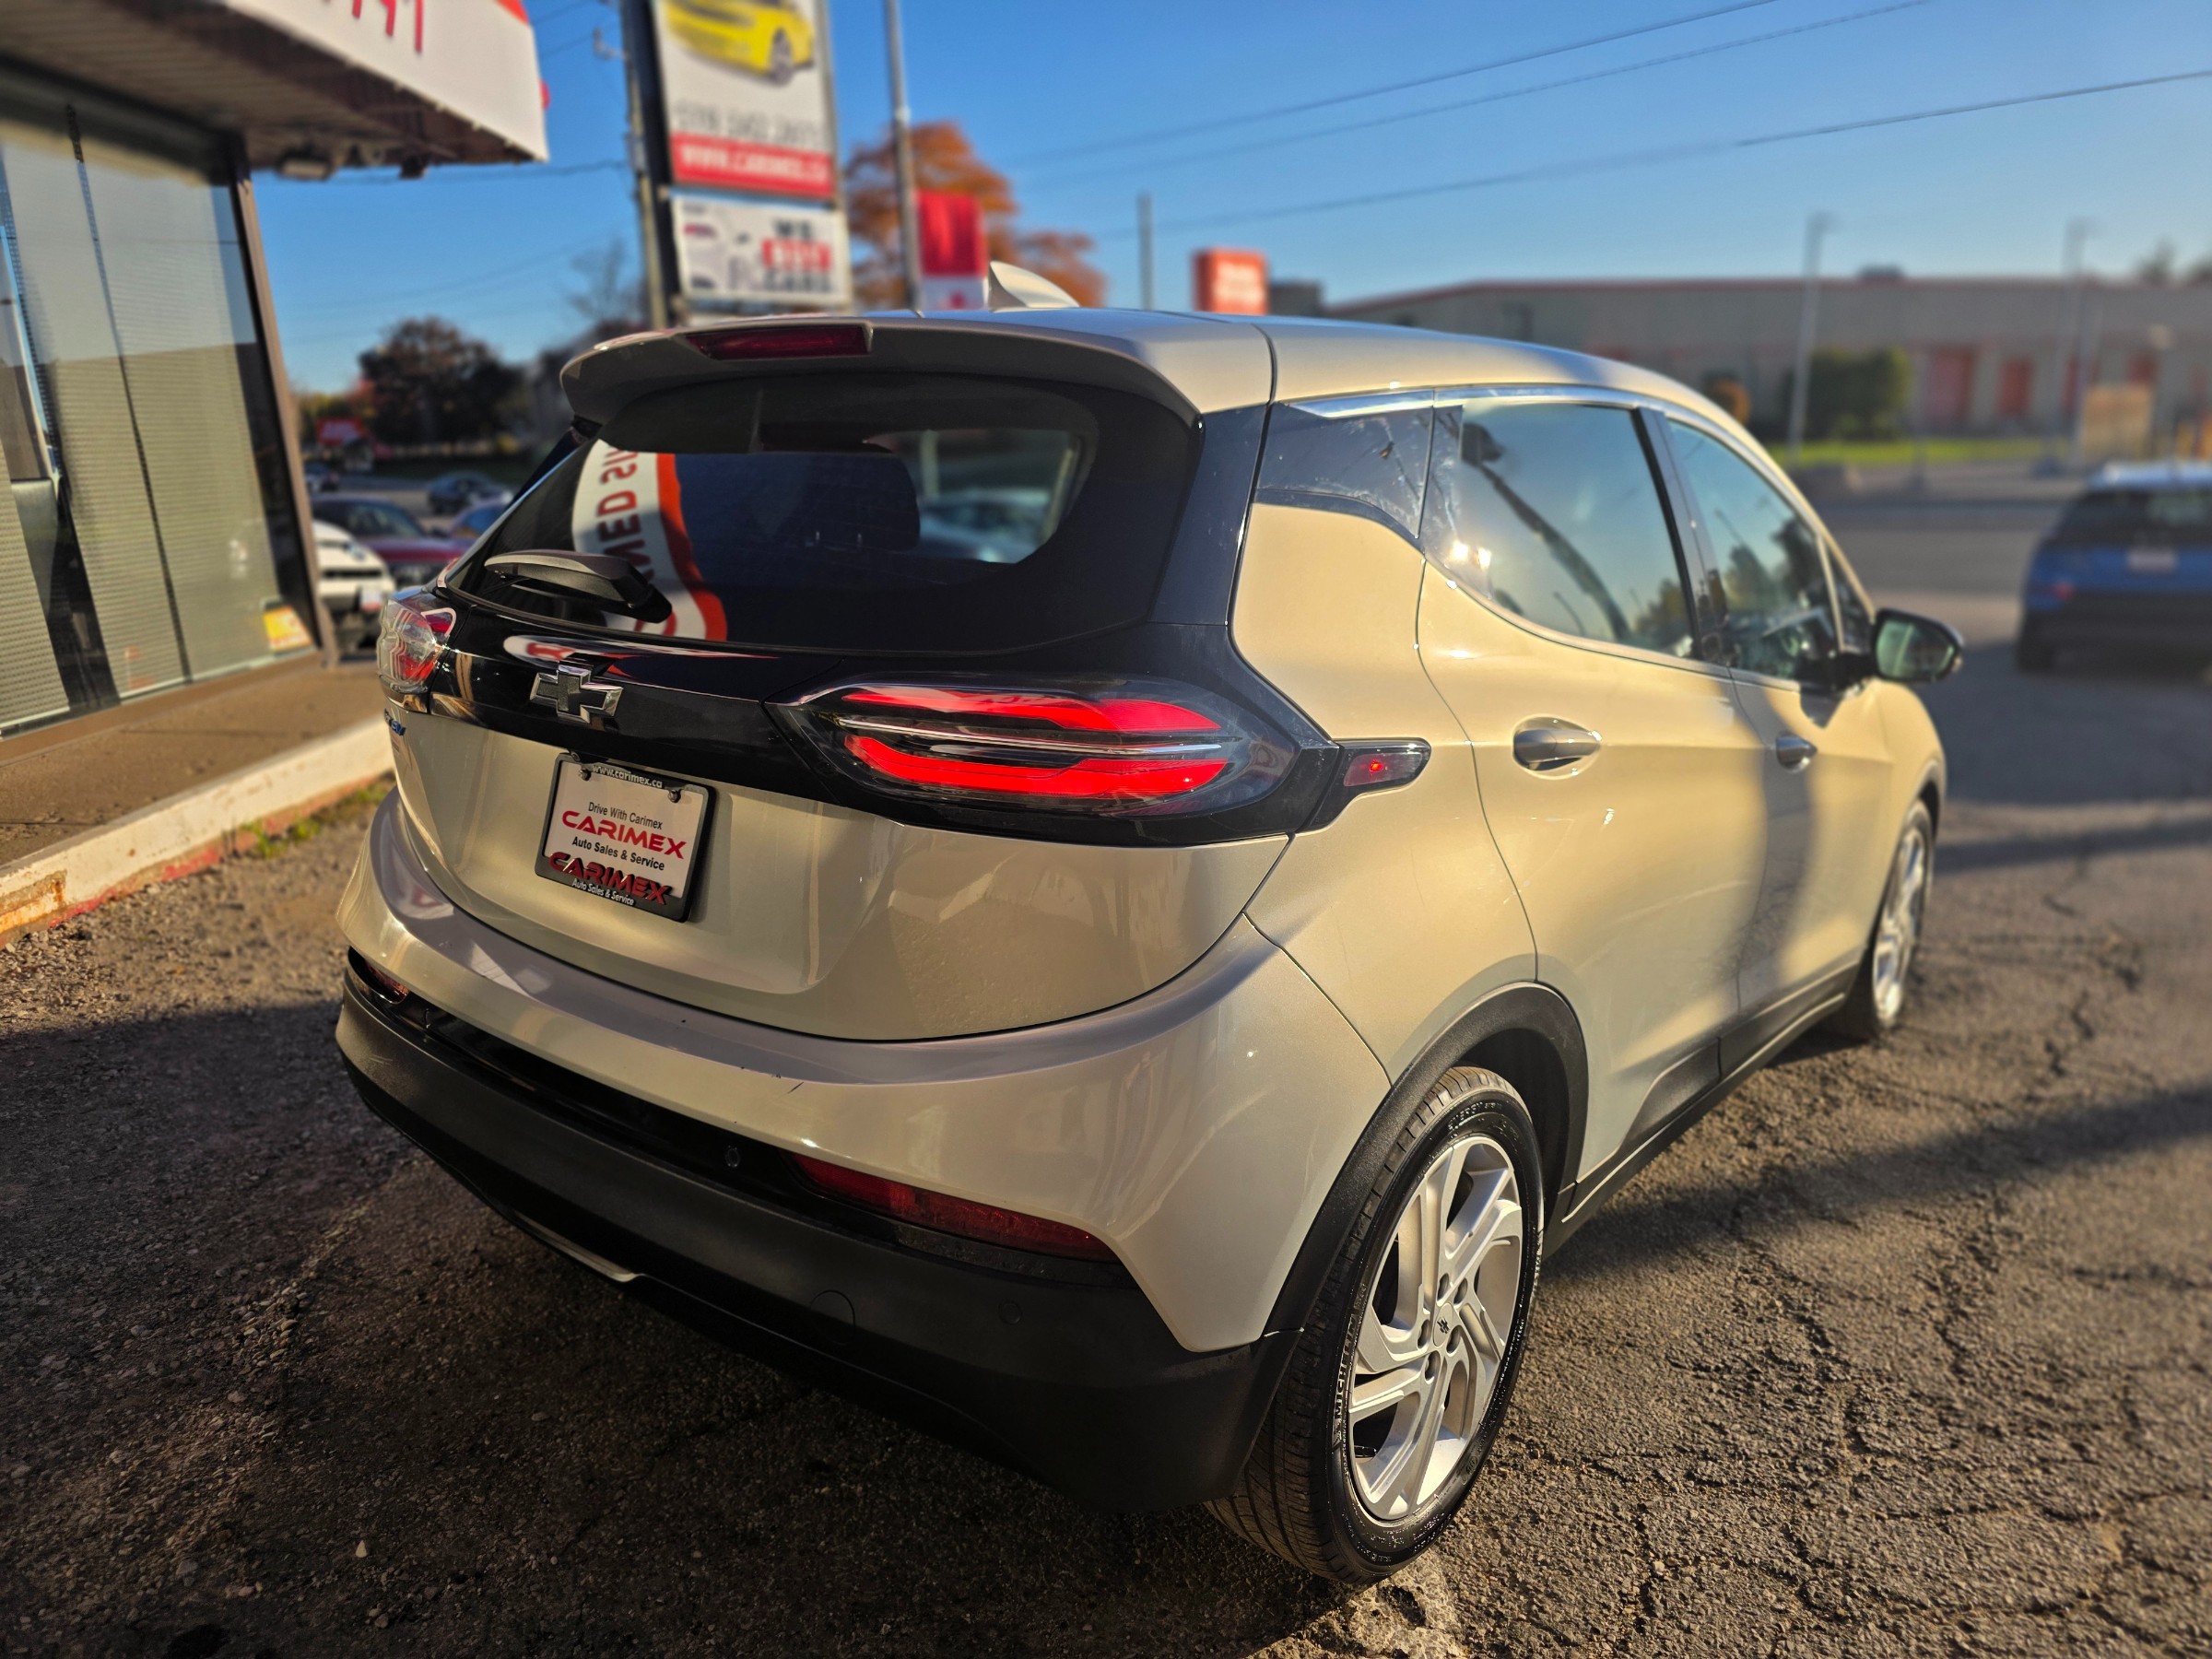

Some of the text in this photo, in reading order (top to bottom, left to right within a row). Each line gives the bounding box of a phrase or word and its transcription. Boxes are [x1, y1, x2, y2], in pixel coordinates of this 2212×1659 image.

[592, 765, 663, 789] www.carimex.ca
[588, 801, 664, 830] Drive With Carimex
[561, 810, 687, 859] CARIMEX
[571, 836, 665, 871] Auto Sales & Service
[548, 851, 672, 905] CARIMEX
[571, 877, 635, 906] Auto Sales & Service
